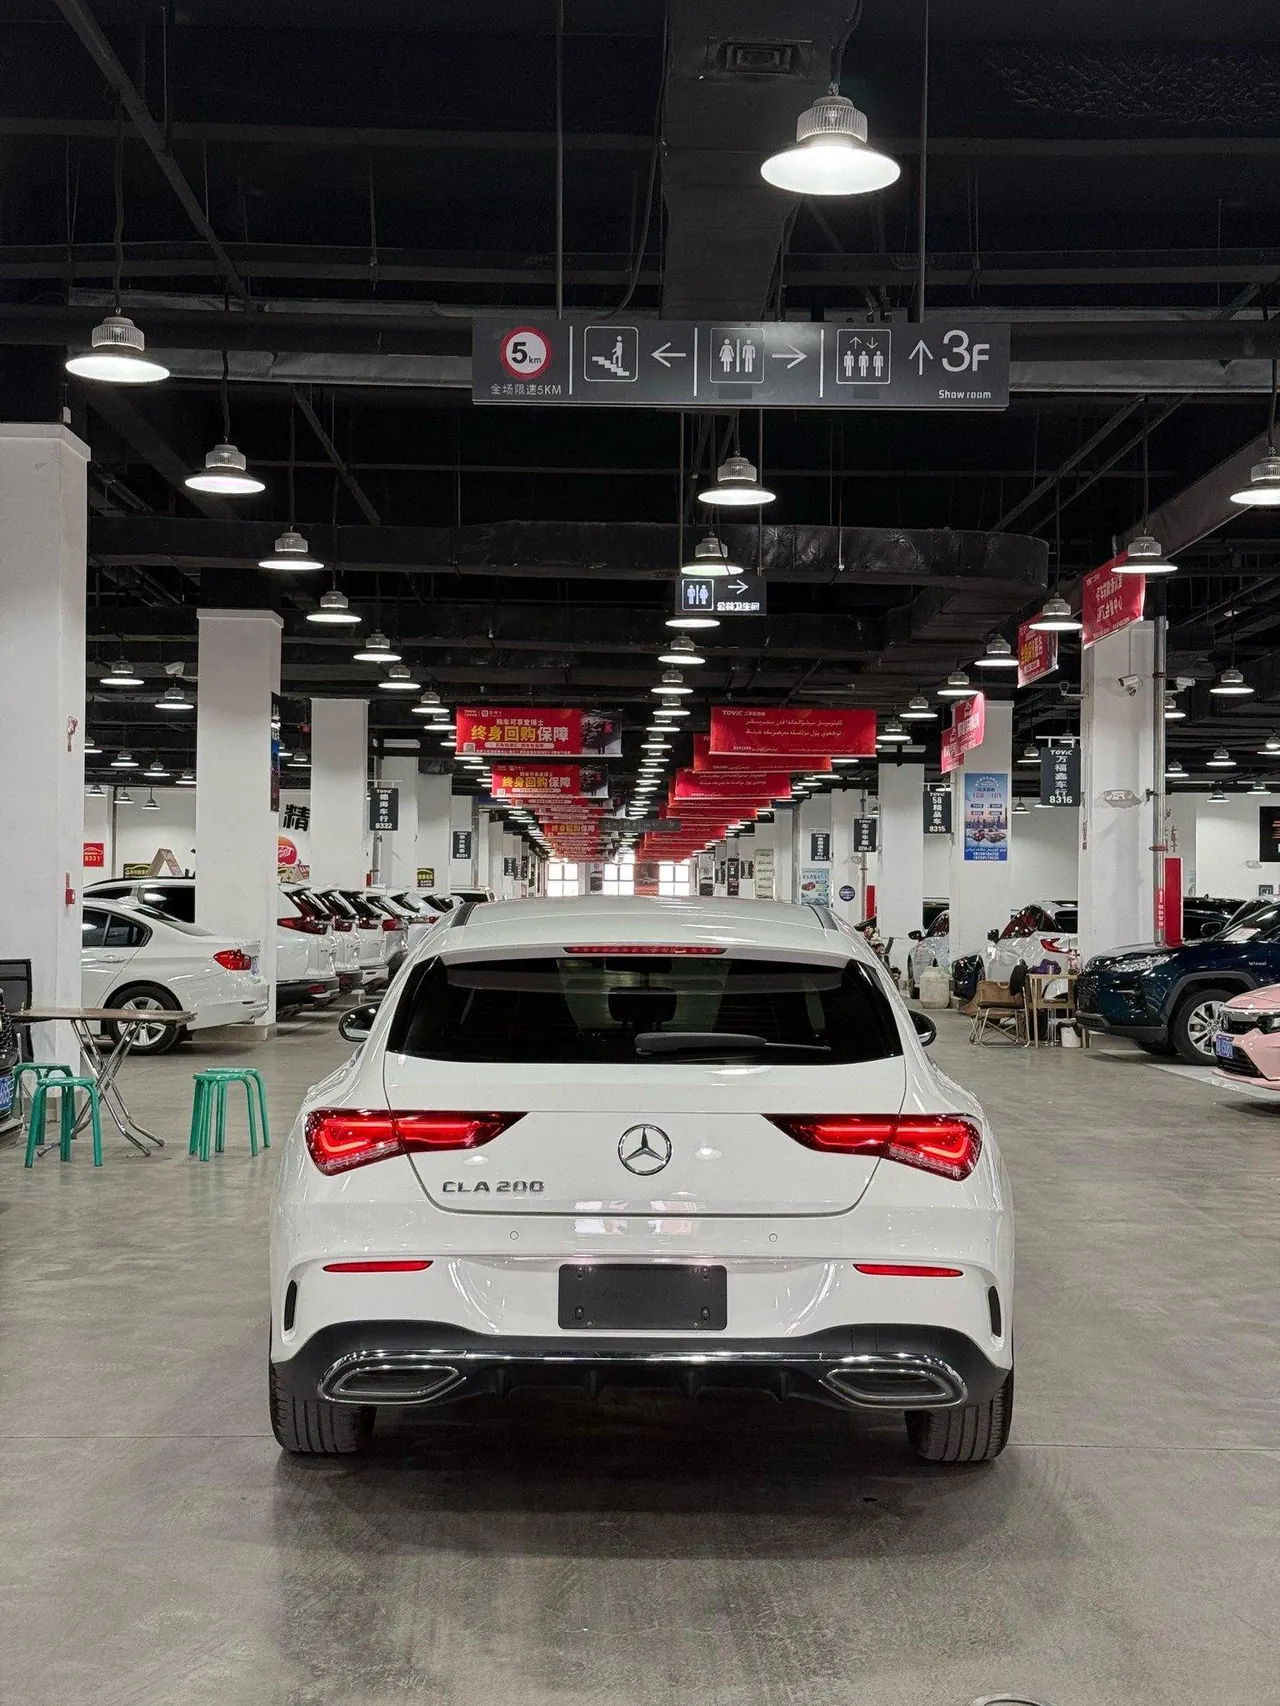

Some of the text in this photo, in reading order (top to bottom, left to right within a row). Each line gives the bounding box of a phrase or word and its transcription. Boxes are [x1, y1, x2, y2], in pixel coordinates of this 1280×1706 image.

[942, 329, 990, 372] 3F
[490, 383, 562, 395] 全场限速5KM
[938, 390, 992, 399] Show room
[716, 601, 760, 612] 公共卫生间
[470, 724, 570, 743] 终身回购保障
[502, 776, 571, 789] 终身回购保障
[1049, 796, 1073, 804] 8316
[282, 804, 311, 832] 精
[442, 1181, 545, 1193] CLA 200
